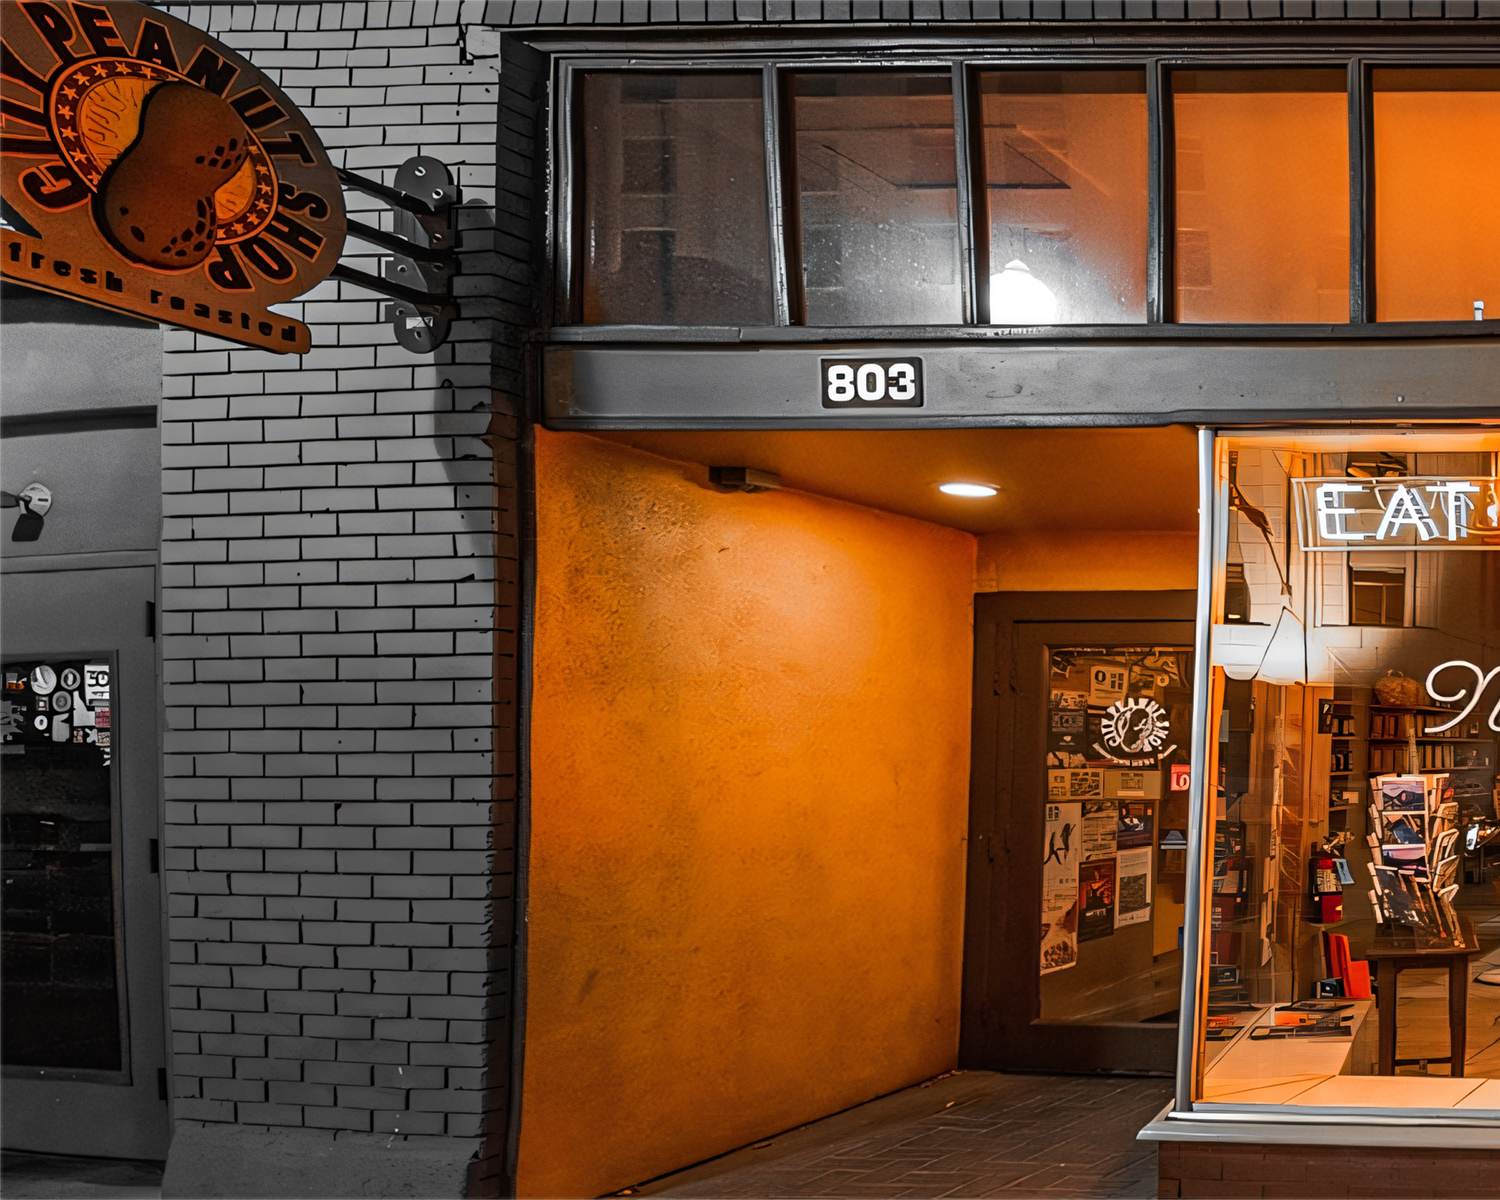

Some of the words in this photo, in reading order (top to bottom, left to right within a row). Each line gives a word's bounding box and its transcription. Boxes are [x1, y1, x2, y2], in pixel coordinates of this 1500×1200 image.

[17, 0, 317, 167] PEANUT
[204, 180, 331, 294] SHOP
[8, 242, 123, 293] fresh
[150, 288, 297, 342] roasted
[827, 363, 916, 402] 803
[1316, 481, 1480, 541] EAT
